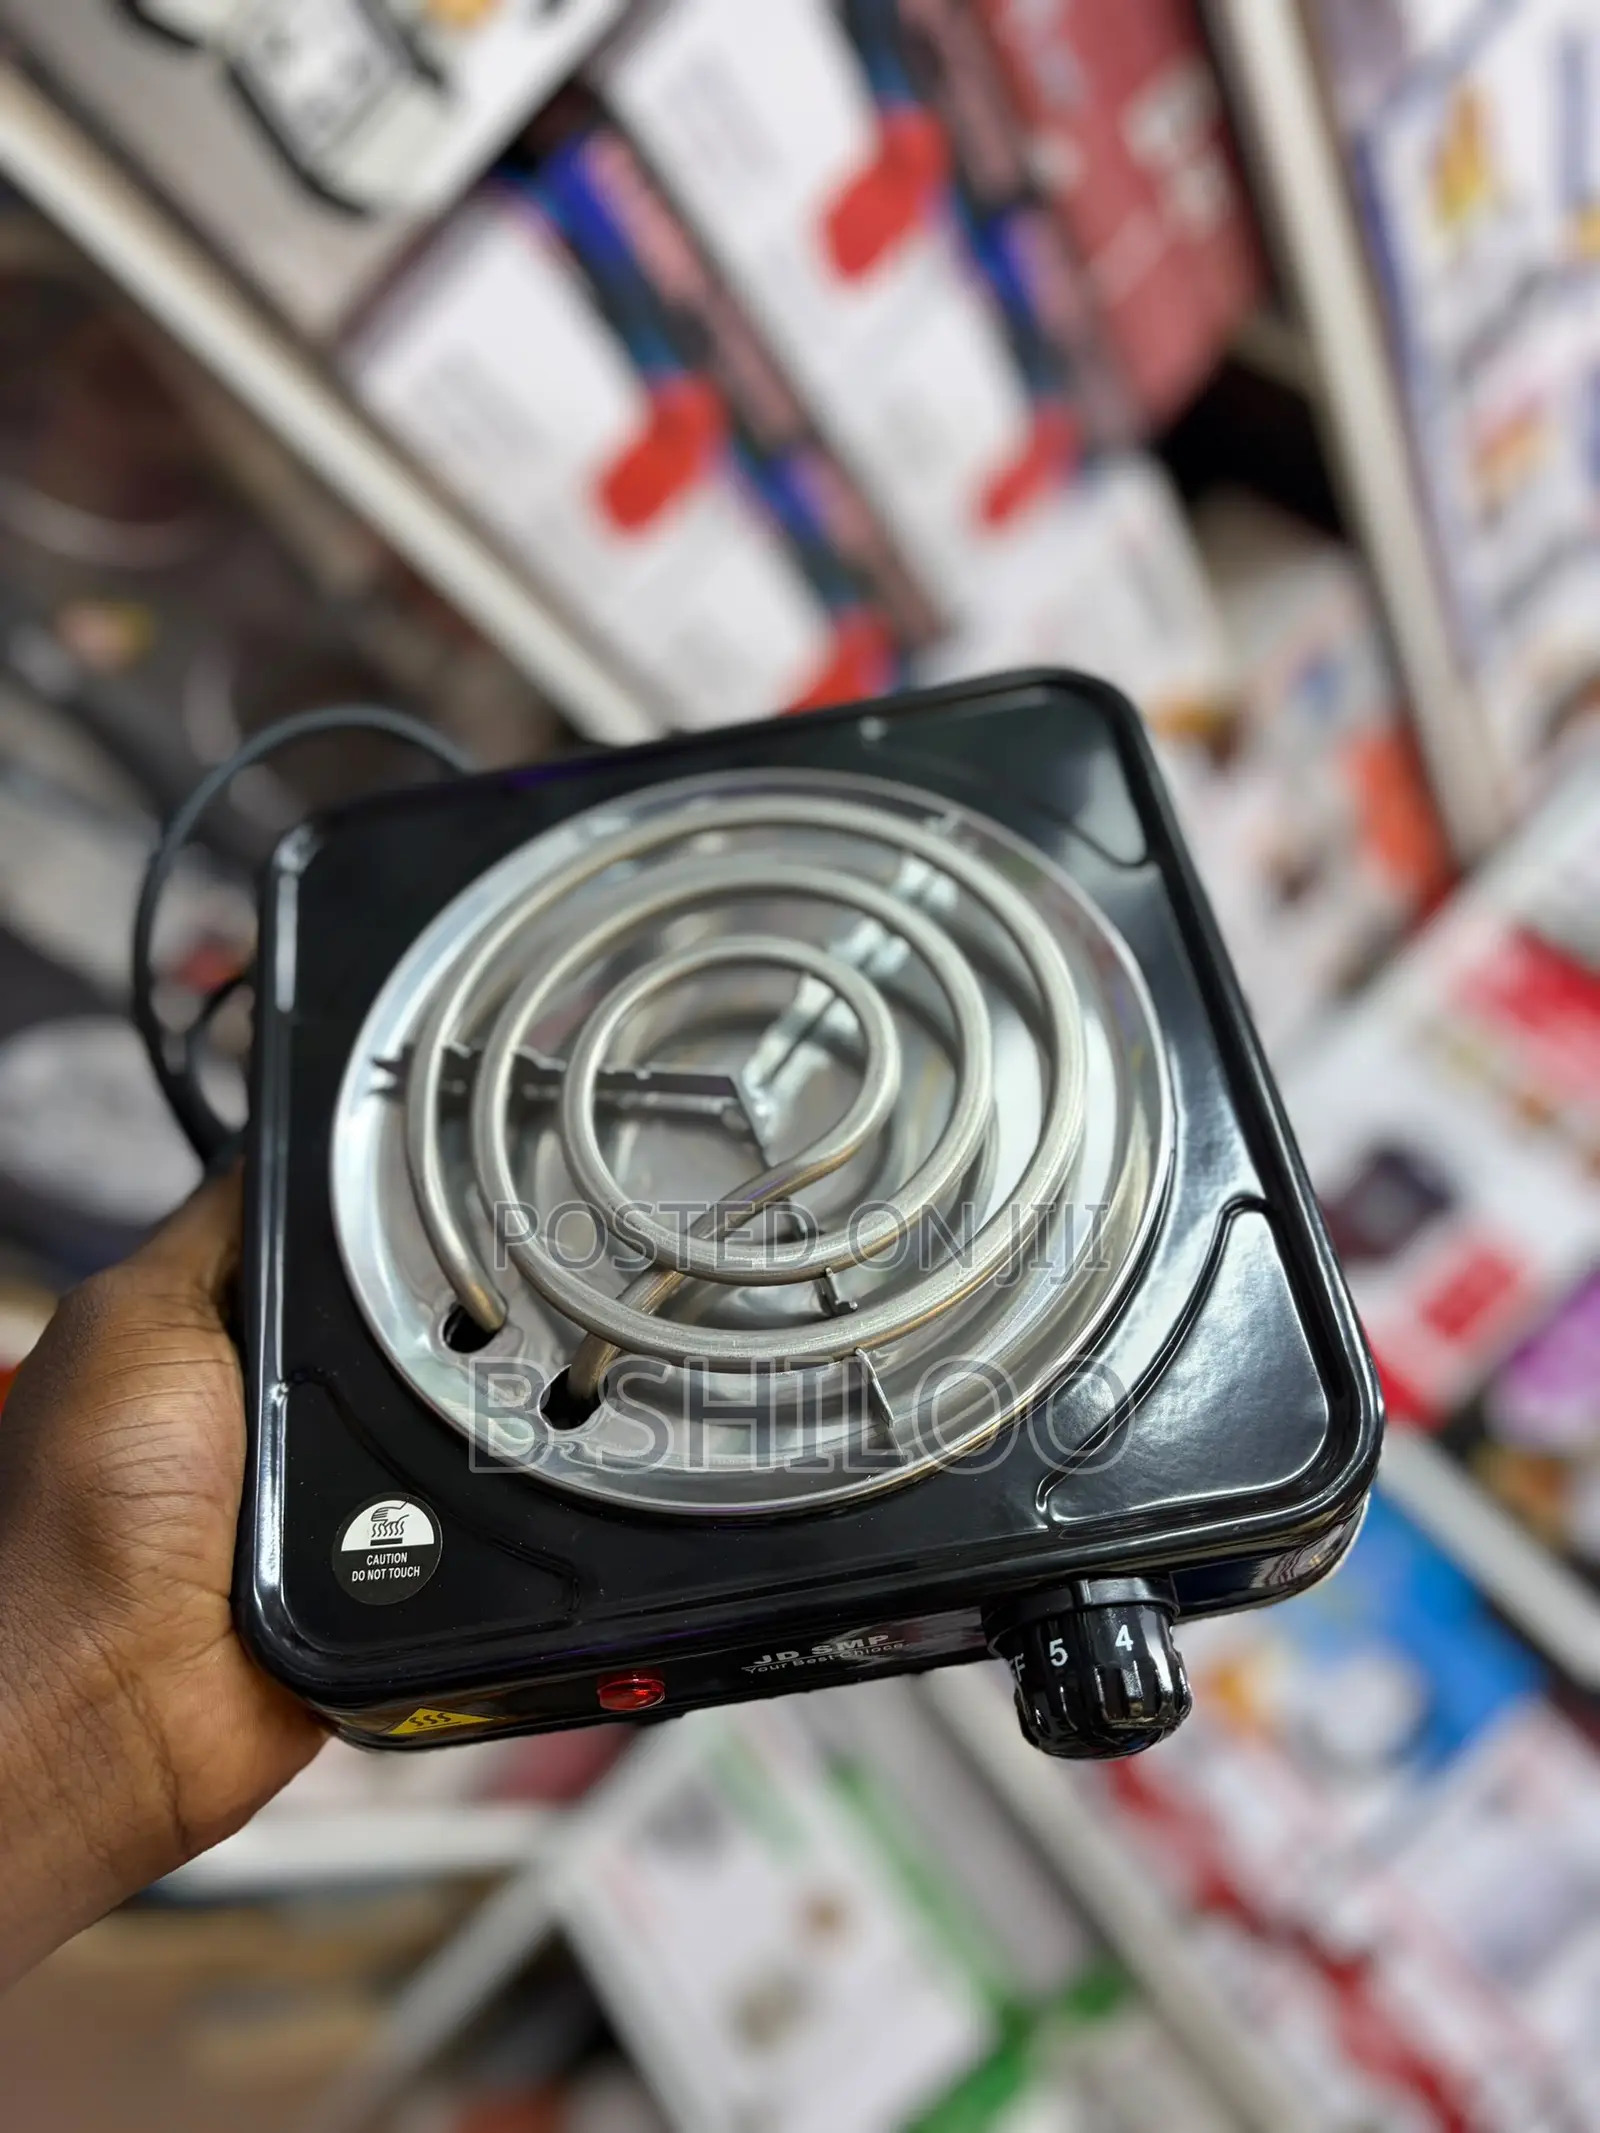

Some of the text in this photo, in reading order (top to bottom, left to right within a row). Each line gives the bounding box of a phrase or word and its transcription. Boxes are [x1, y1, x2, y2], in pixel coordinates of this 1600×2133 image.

[366, 1552, 408, 1566] CAUTION
[351, 1566, 420, 1582] DO NOT TOUCH
[753, 1634, 889, 1665] JD SMP
[1049, 1638, 1068, 1667] 5
[1115, 1624, 1134, 1652] 4
[742, 1662, 788, 1674] Your
[792, 1653, 835, 1667] Best
